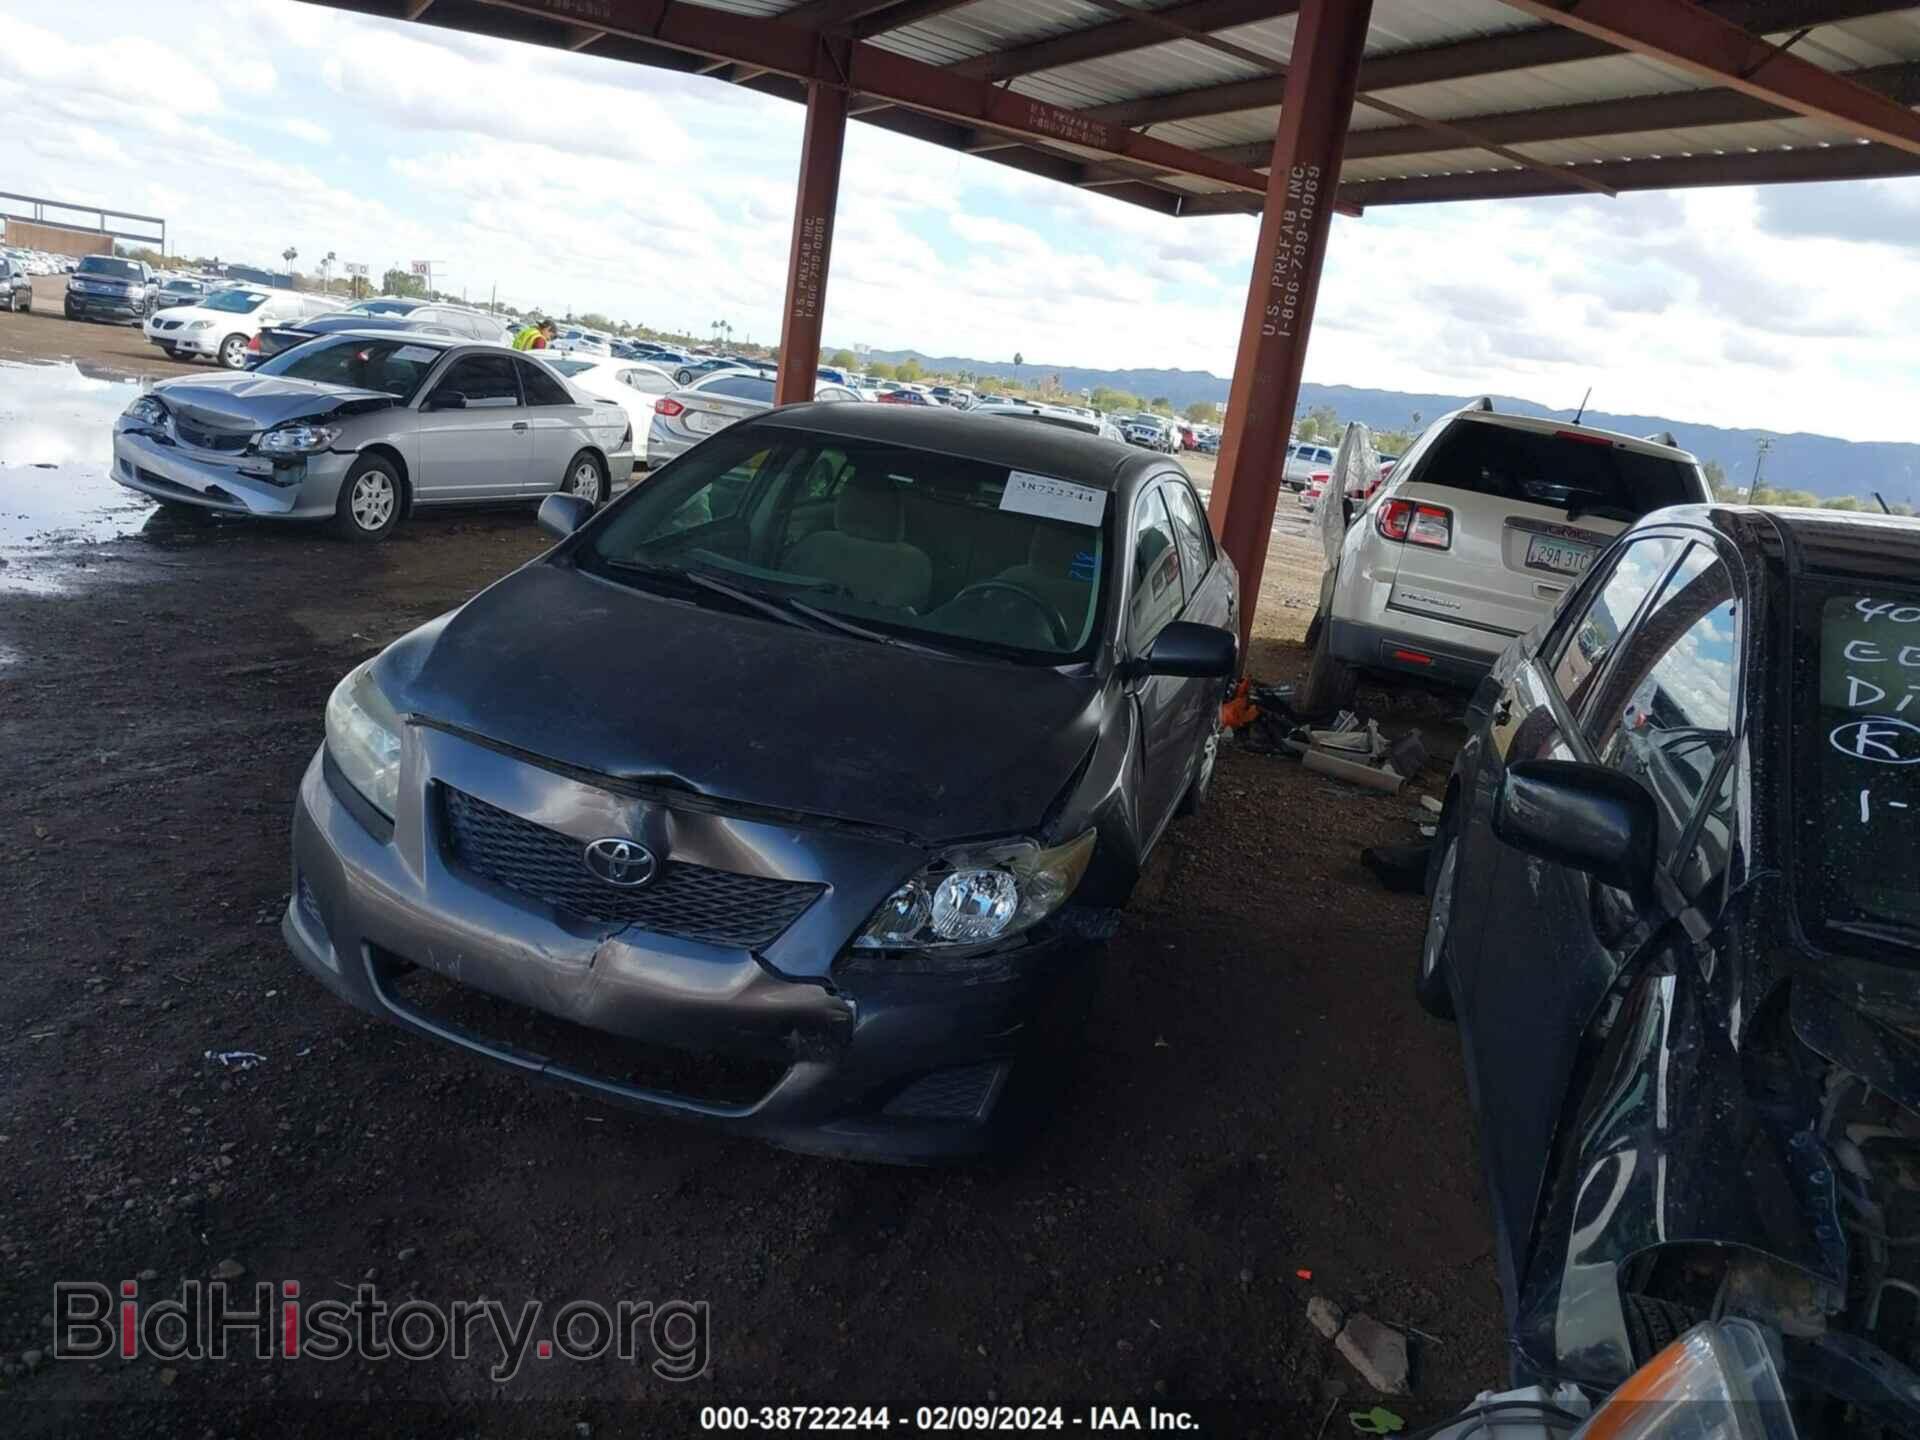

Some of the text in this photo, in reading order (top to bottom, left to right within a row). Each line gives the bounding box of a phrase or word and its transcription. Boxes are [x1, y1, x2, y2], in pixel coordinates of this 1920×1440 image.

[798, 242, 812, 289] PREFAB
[1262, 162, 1307, 336] U.S. PREFAB INC.
[1278, 165, 1321, 337] 1-866-799-0969
